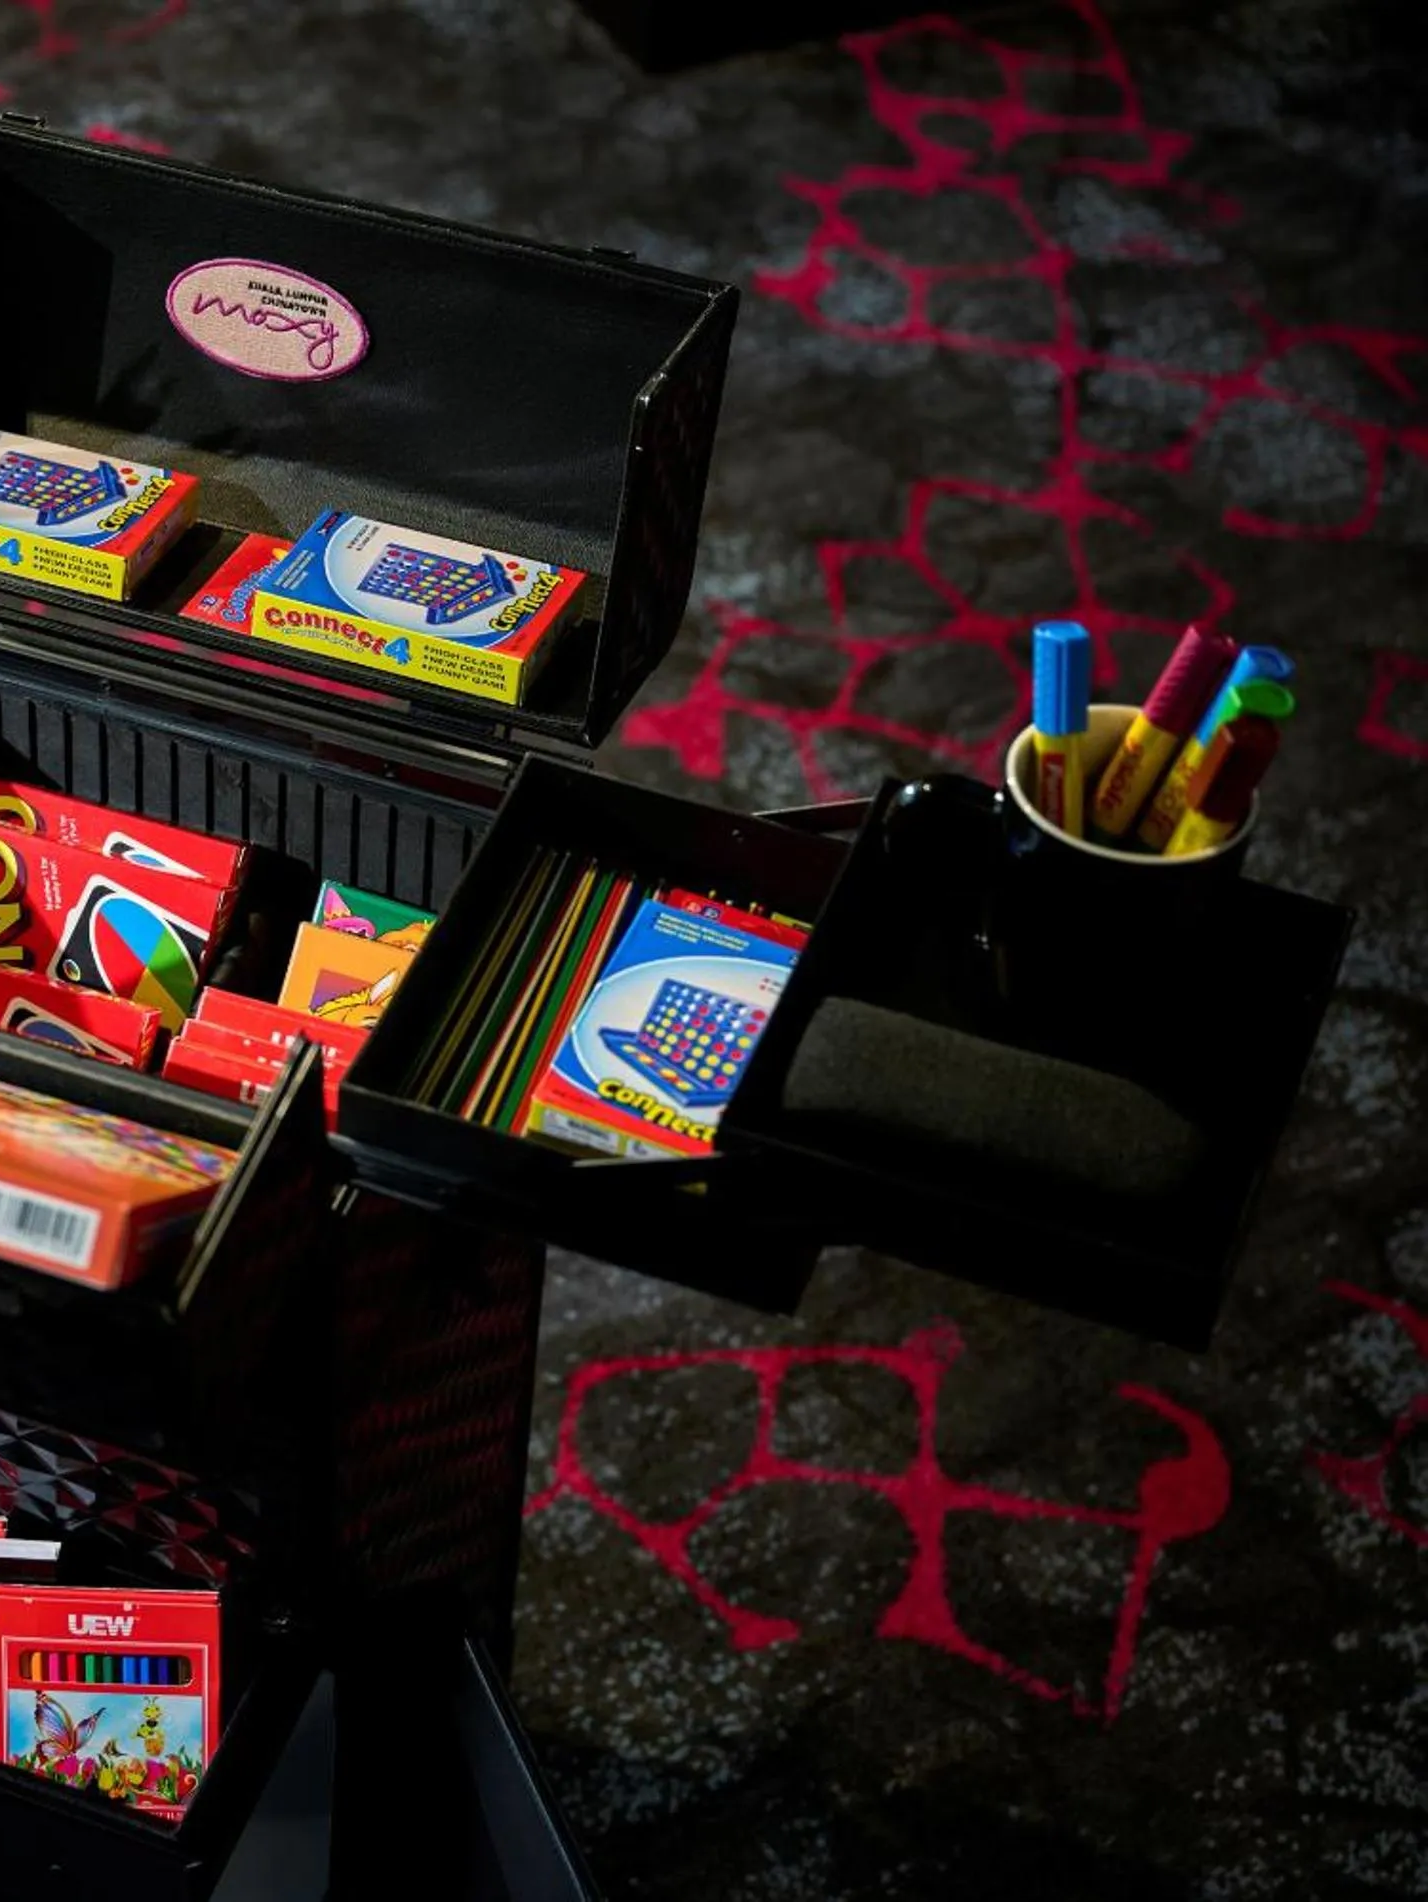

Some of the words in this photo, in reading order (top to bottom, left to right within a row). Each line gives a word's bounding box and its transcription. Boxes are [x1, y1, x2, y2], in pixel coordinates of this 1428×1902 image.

[261, 296, 327, 318] CHINATOWN
[286, 289, 328, 306] LUMPUR
[489, 581, 552, 632] Connect
[263, 606, 388, 655] Connect
[383, 636, 412, 665] 4
[596, 1077, 718, 1143] Connect
[68, 1614, 134, 1637] UEW
